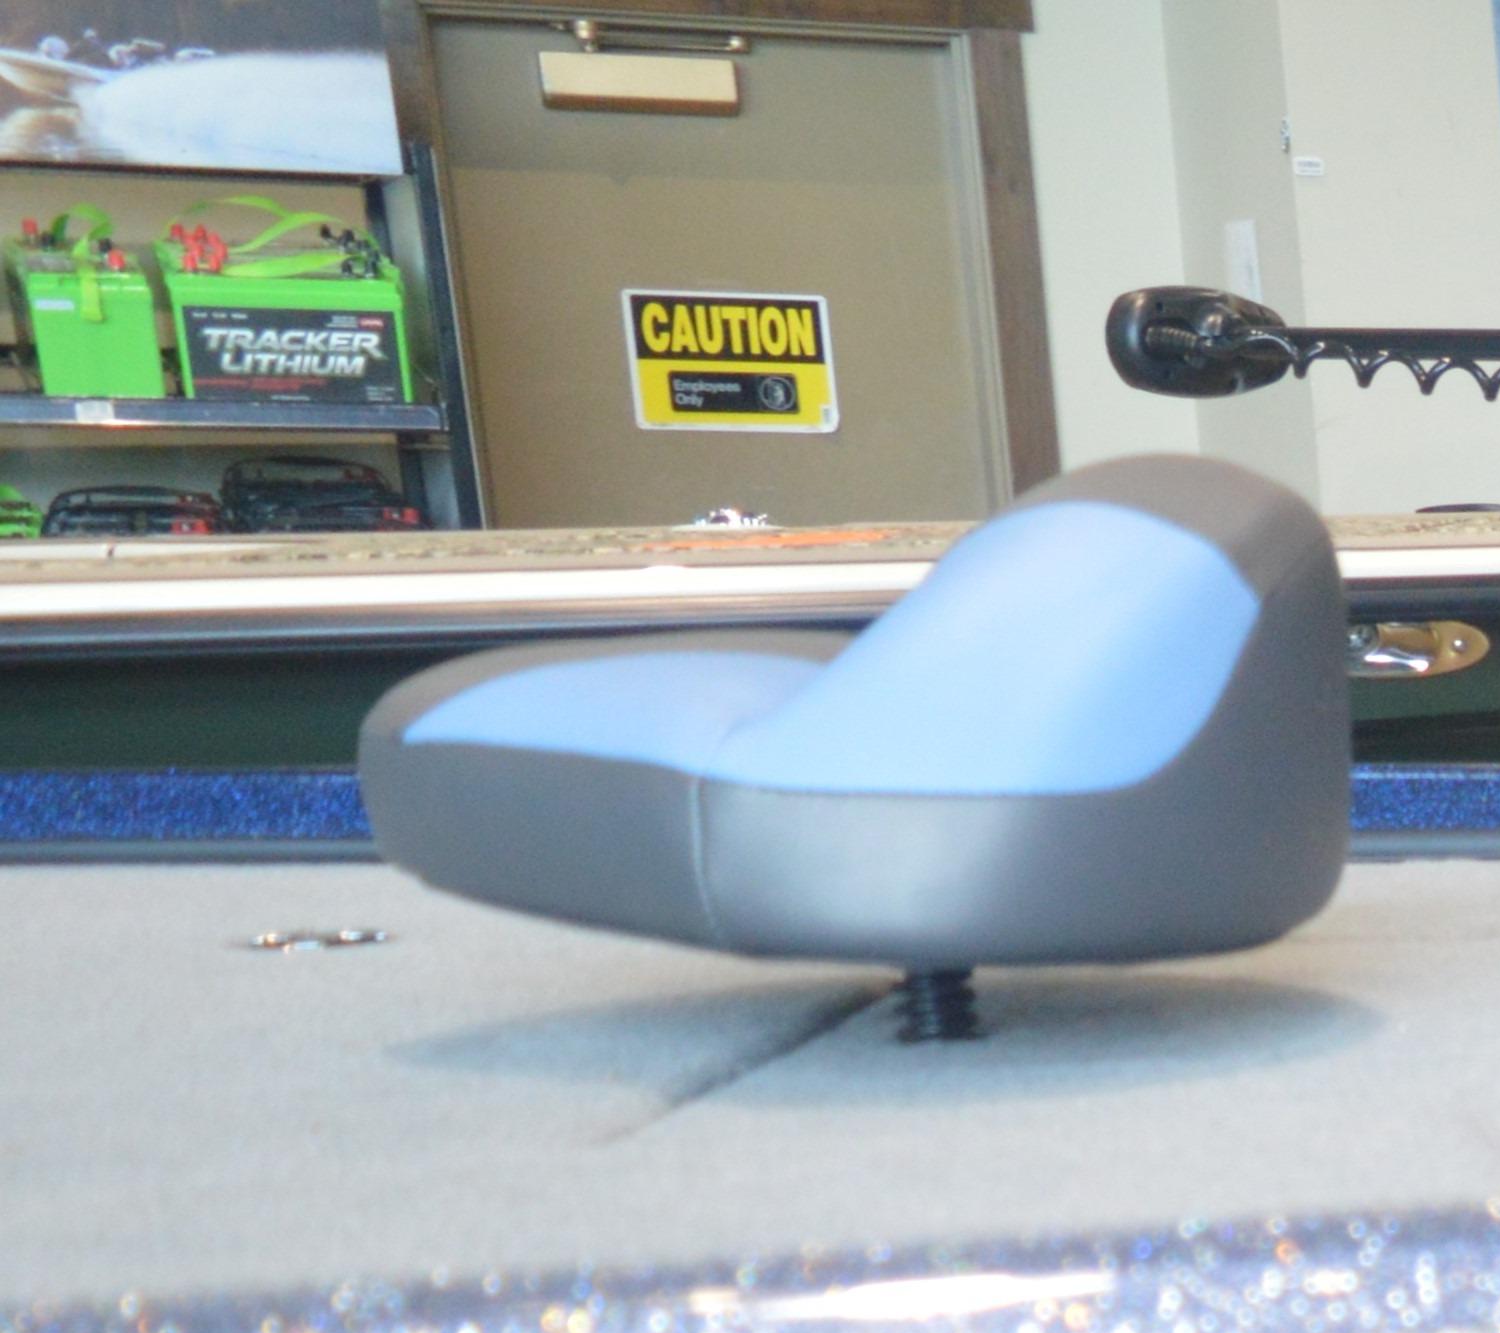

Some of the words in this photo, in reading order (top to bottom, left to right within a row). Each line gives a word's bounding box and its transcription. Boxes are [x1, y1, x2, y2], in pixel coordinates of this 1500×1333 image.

[641, 302, 816, 356] CAUTION
[199, 327, 389, 360] TRACKER
[220, 353, 366, 375] LITHIUM
[673, 379, 741, 394] Employees
[675, 393, 704, 407] Only
